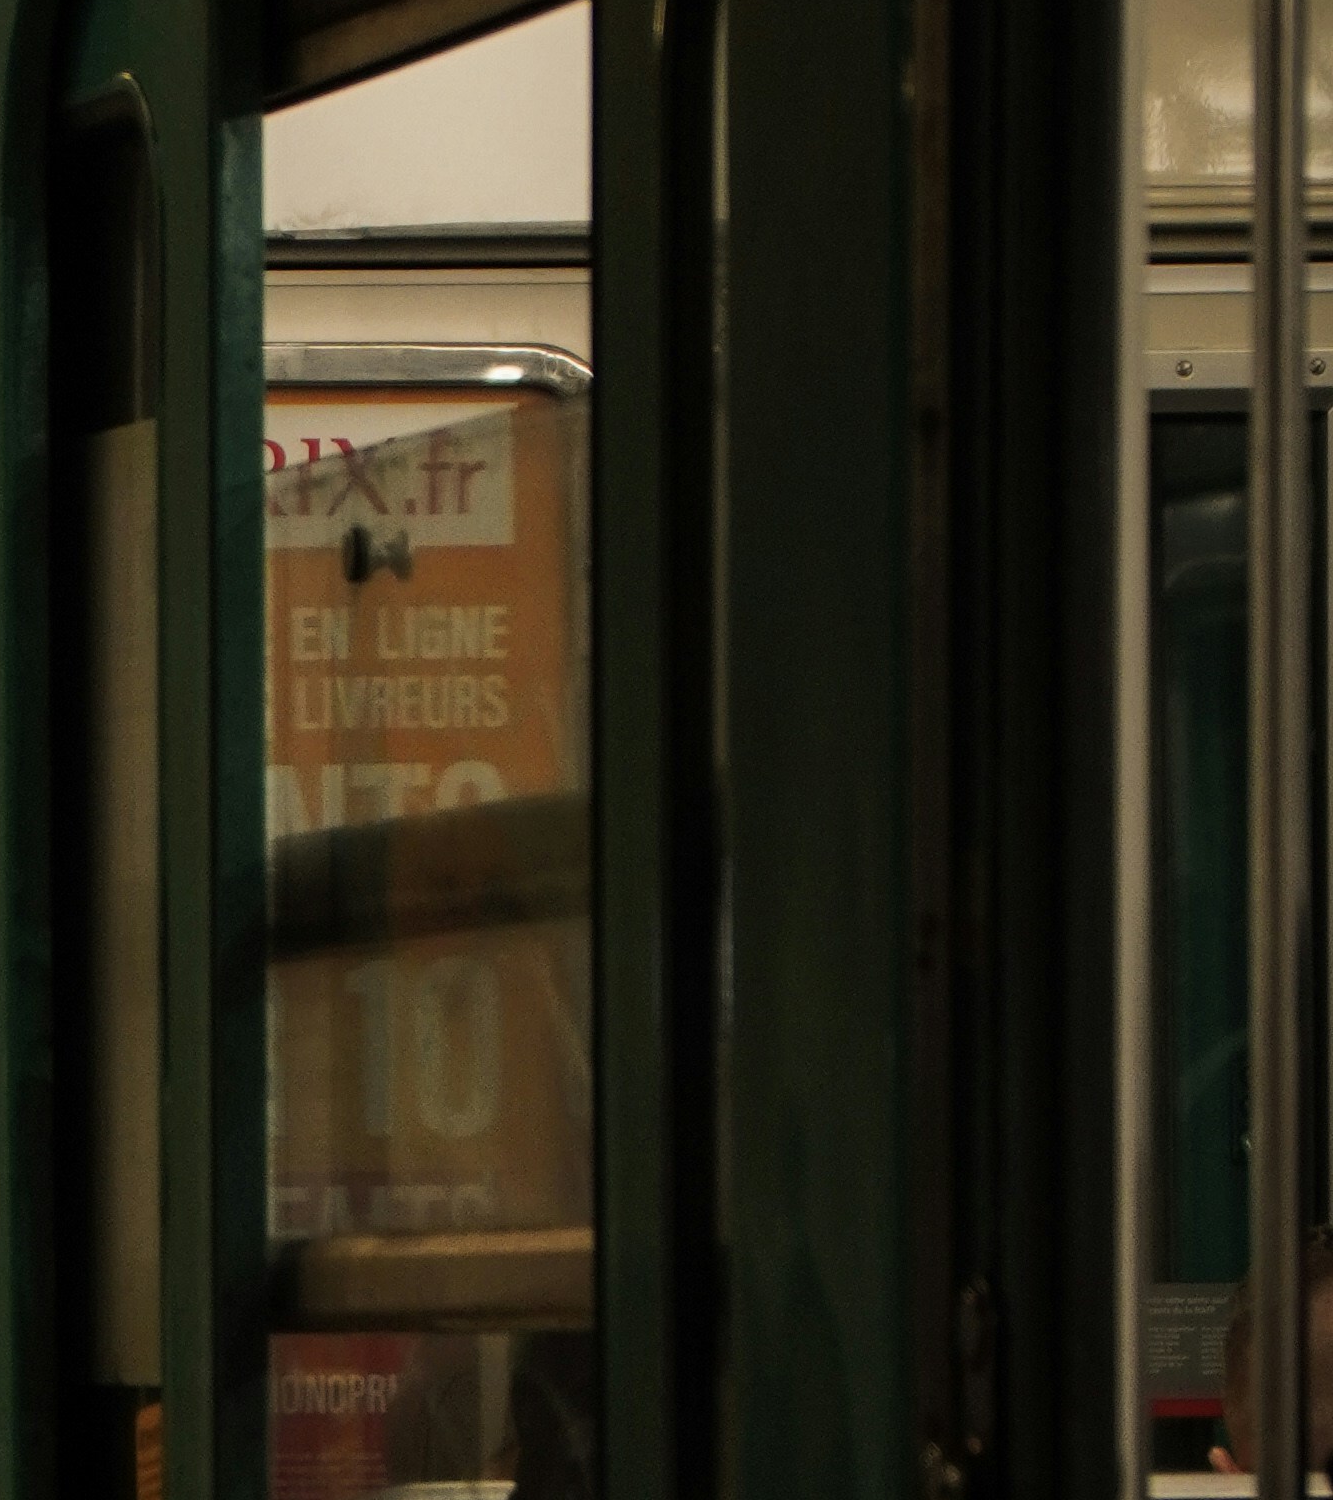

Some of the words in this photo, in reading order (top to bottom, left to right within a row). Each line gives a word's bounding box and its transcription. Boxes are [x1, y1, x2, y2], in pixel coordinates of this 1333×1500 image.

[291, 605, 350, 661] EN
[377, 604, 509, 661] LIGNE
[294, 674, 509, 730] LIVREURS
